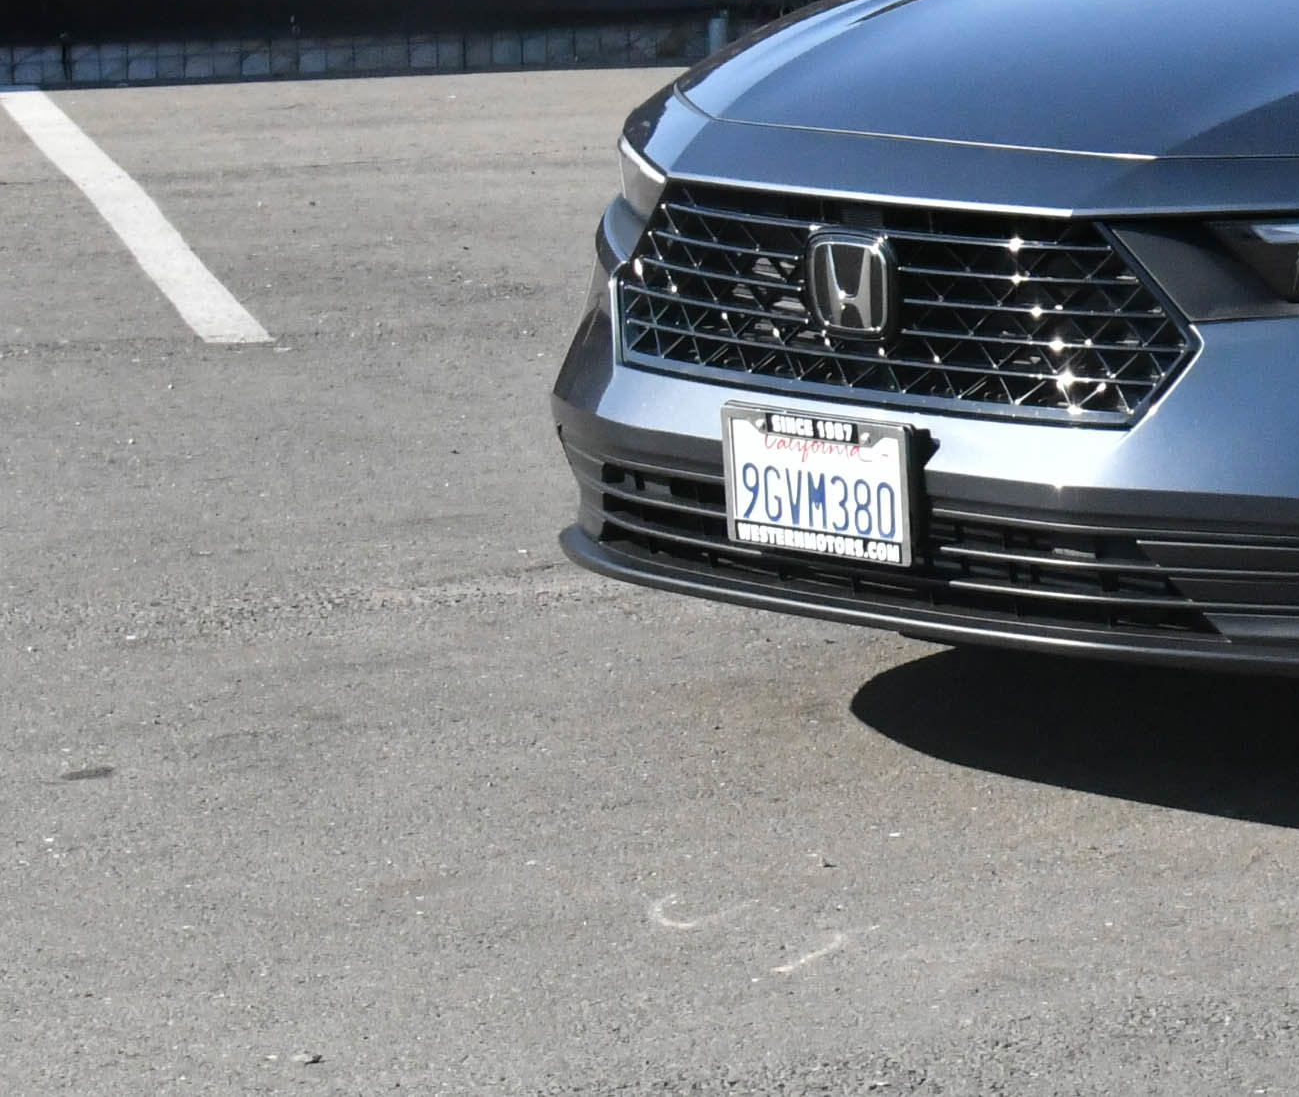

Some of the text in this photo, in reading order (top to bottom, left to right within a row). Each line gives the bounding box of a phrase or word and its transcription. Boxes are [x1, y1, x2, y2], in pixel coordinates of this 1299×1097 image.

[771, 414, 814, 437] SINCE
[742, 462, 896, 539] 9GVM380
[737, 522, 901, 563] WESTERNMOTORS.COM
